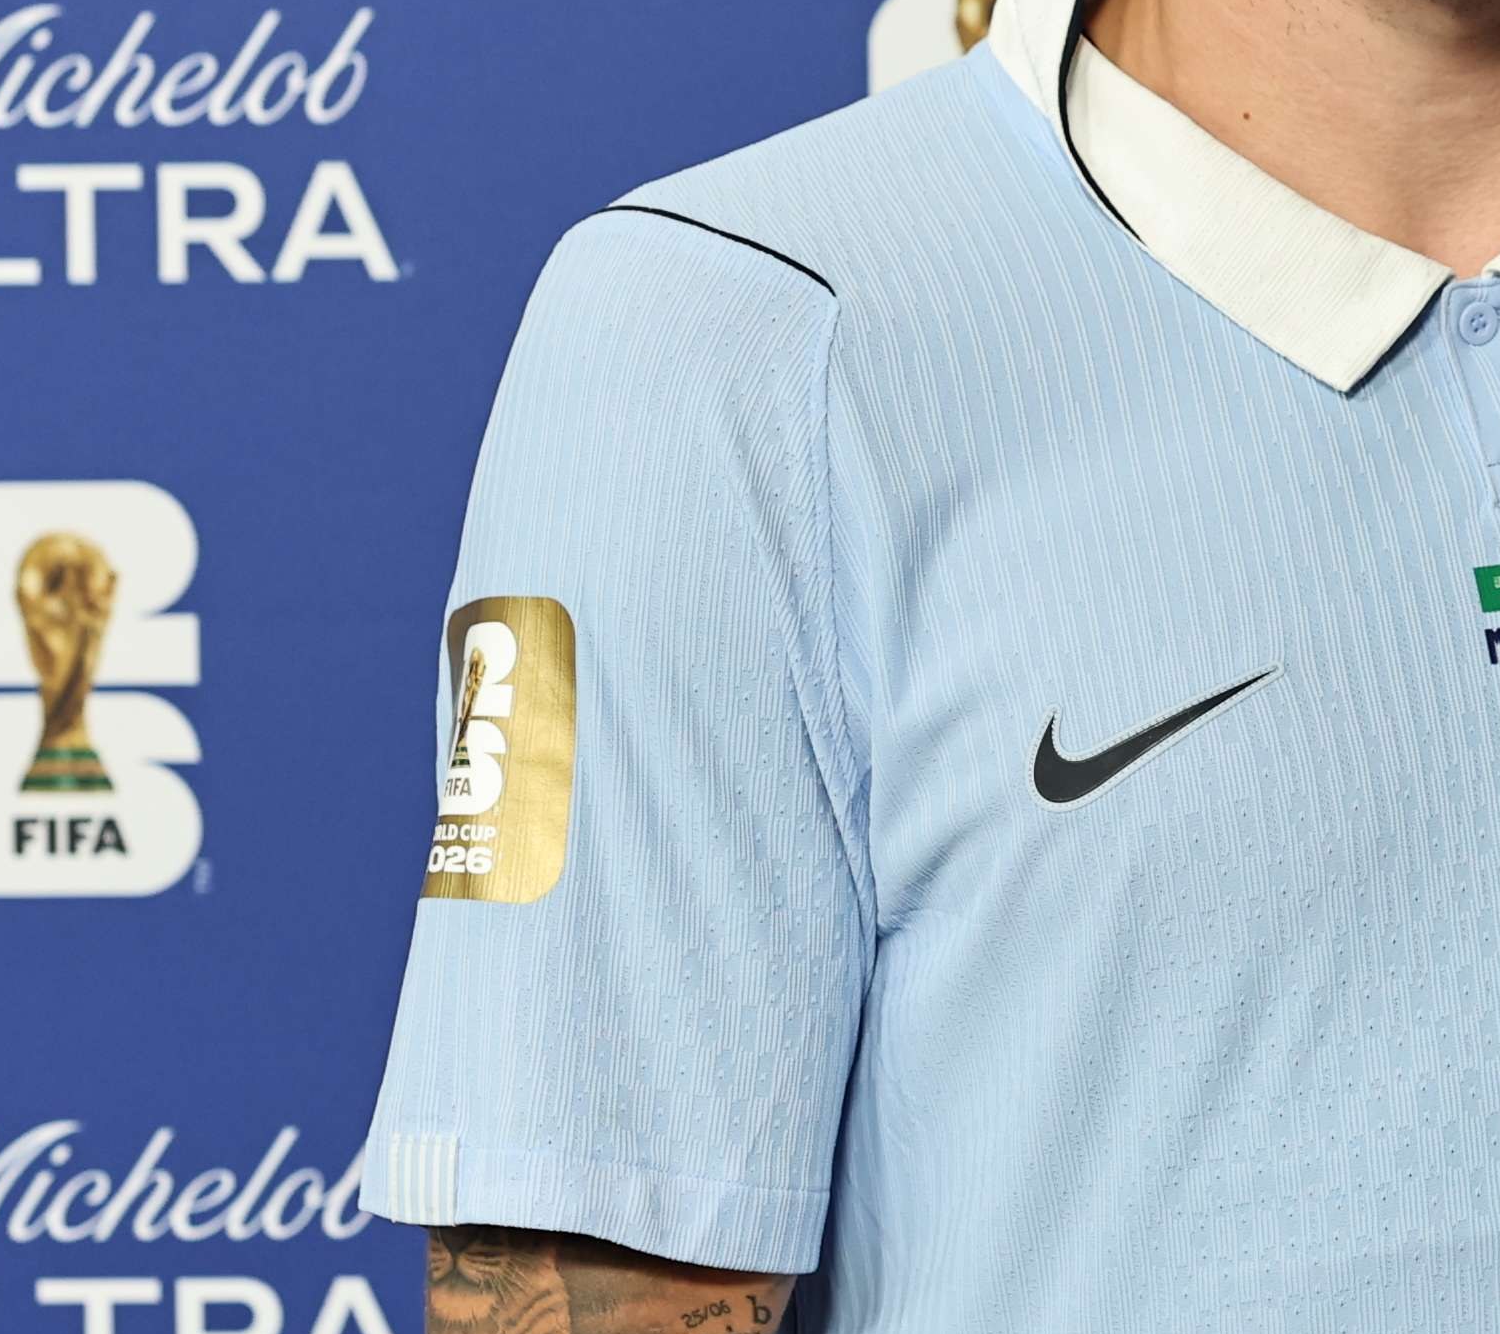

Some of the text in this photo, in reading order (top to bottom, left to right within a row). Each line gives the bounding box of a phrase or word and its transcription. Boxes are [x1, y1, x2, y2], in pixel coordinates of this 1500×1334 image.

[13, 817, 127, 856] FIFA
[459, 822, 497, 843] CUP
[427, 844, 494, 875] 026
